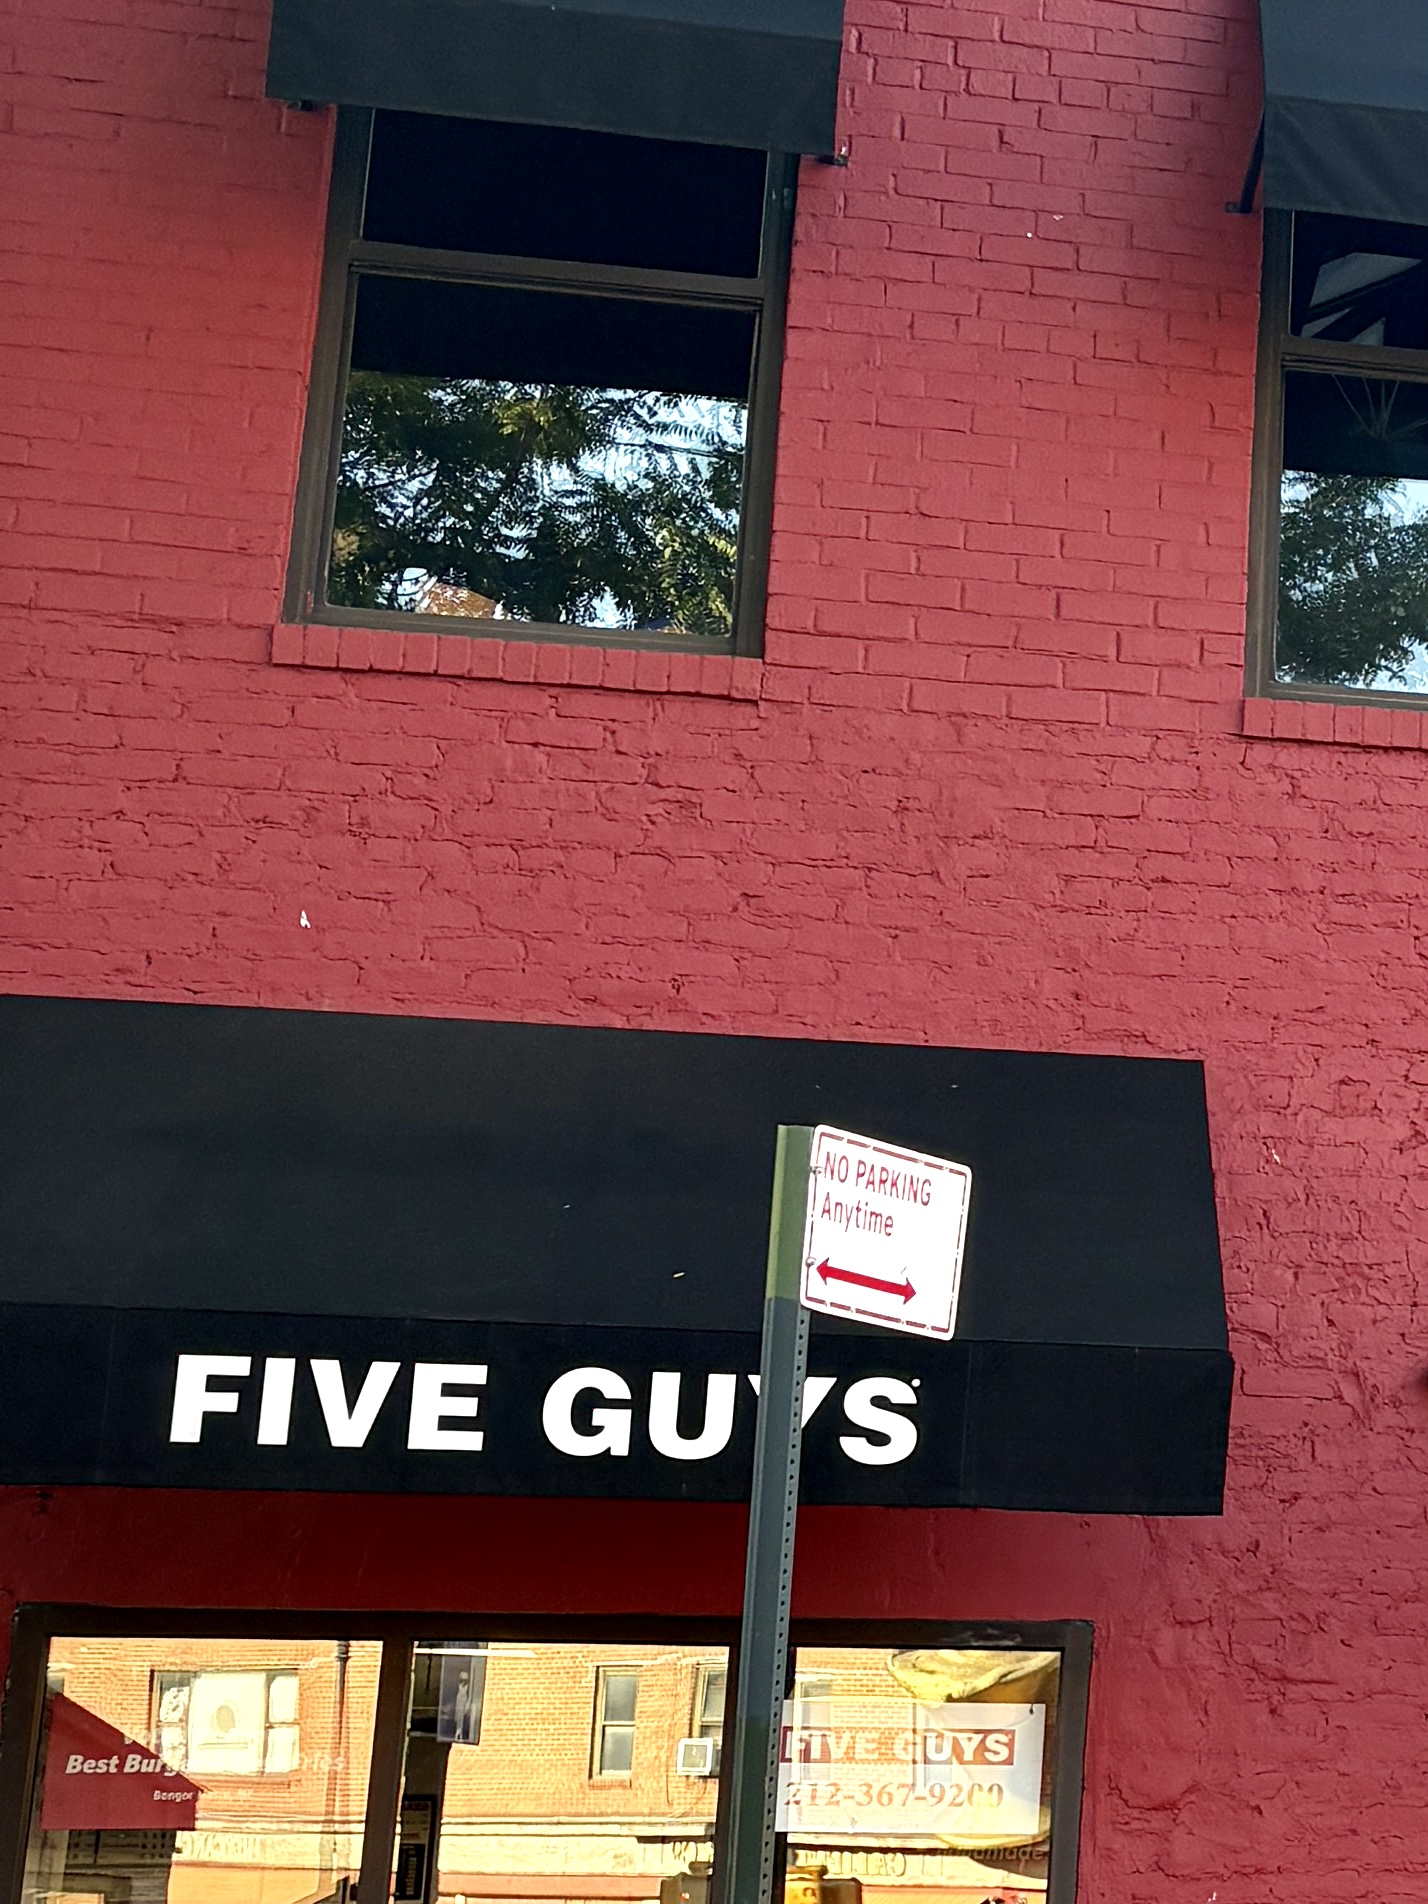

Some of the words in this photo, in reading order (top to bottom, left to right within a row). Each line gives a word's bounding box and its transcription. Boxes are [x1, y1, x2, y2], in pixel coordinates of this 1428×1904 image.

[823, 1151, 849, 1183] NO
[855, 1159, 932, 1206] PARKING
[820, 1192, 894, 1237] Anytime
[169, 1353, 489, 1452] FIVE
[65, 1754, 119, 1775] Best
[123, 1753, 190, 1778] Burg
[784, 1728, 881, 1761] FIVE
[891, 1729, 1012, 1763] GUYS
[784, 1781, 1004, 1808] 212-367-9200
